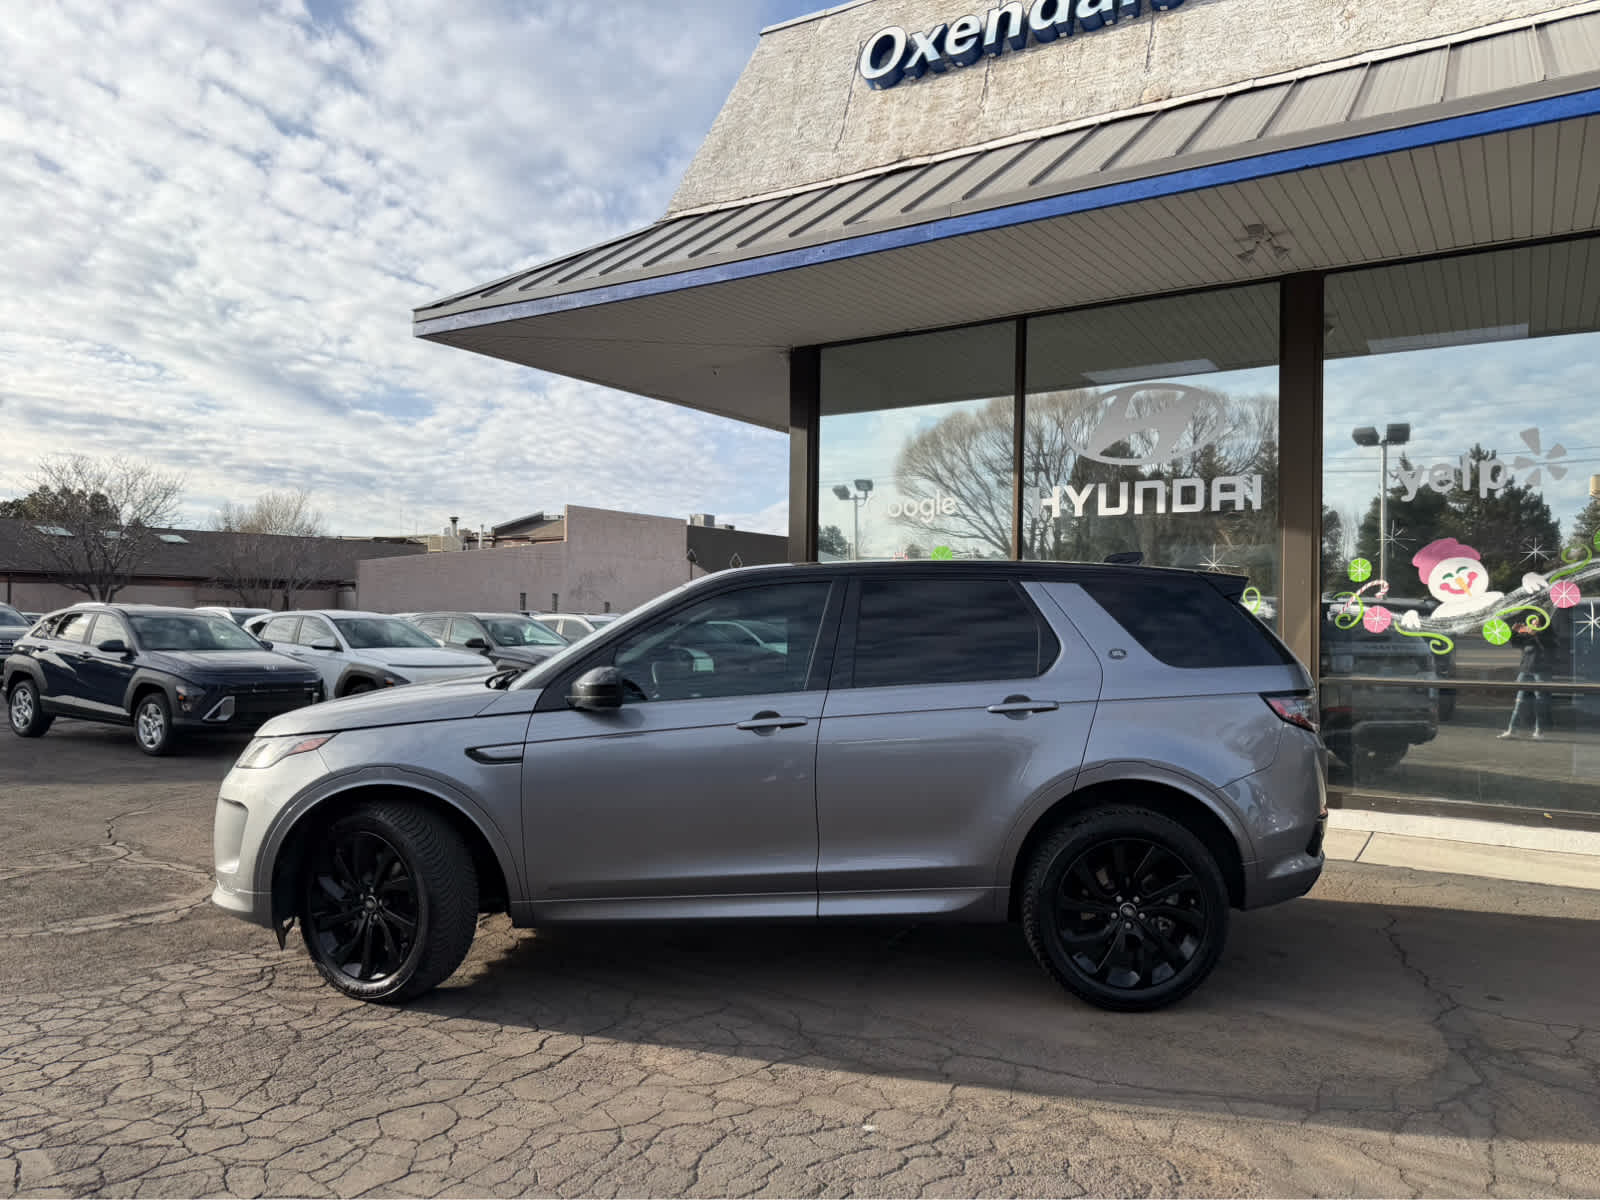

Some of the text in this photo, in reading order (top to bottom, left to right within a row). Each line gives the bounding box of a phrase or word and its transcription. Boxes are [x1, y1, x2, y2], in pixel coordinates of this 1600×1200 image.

[1031, 474, 1262, 518] HYUNDAI
[1395, 455, 1508, 502] yelp
[882, 490, 957, 523] oogle
